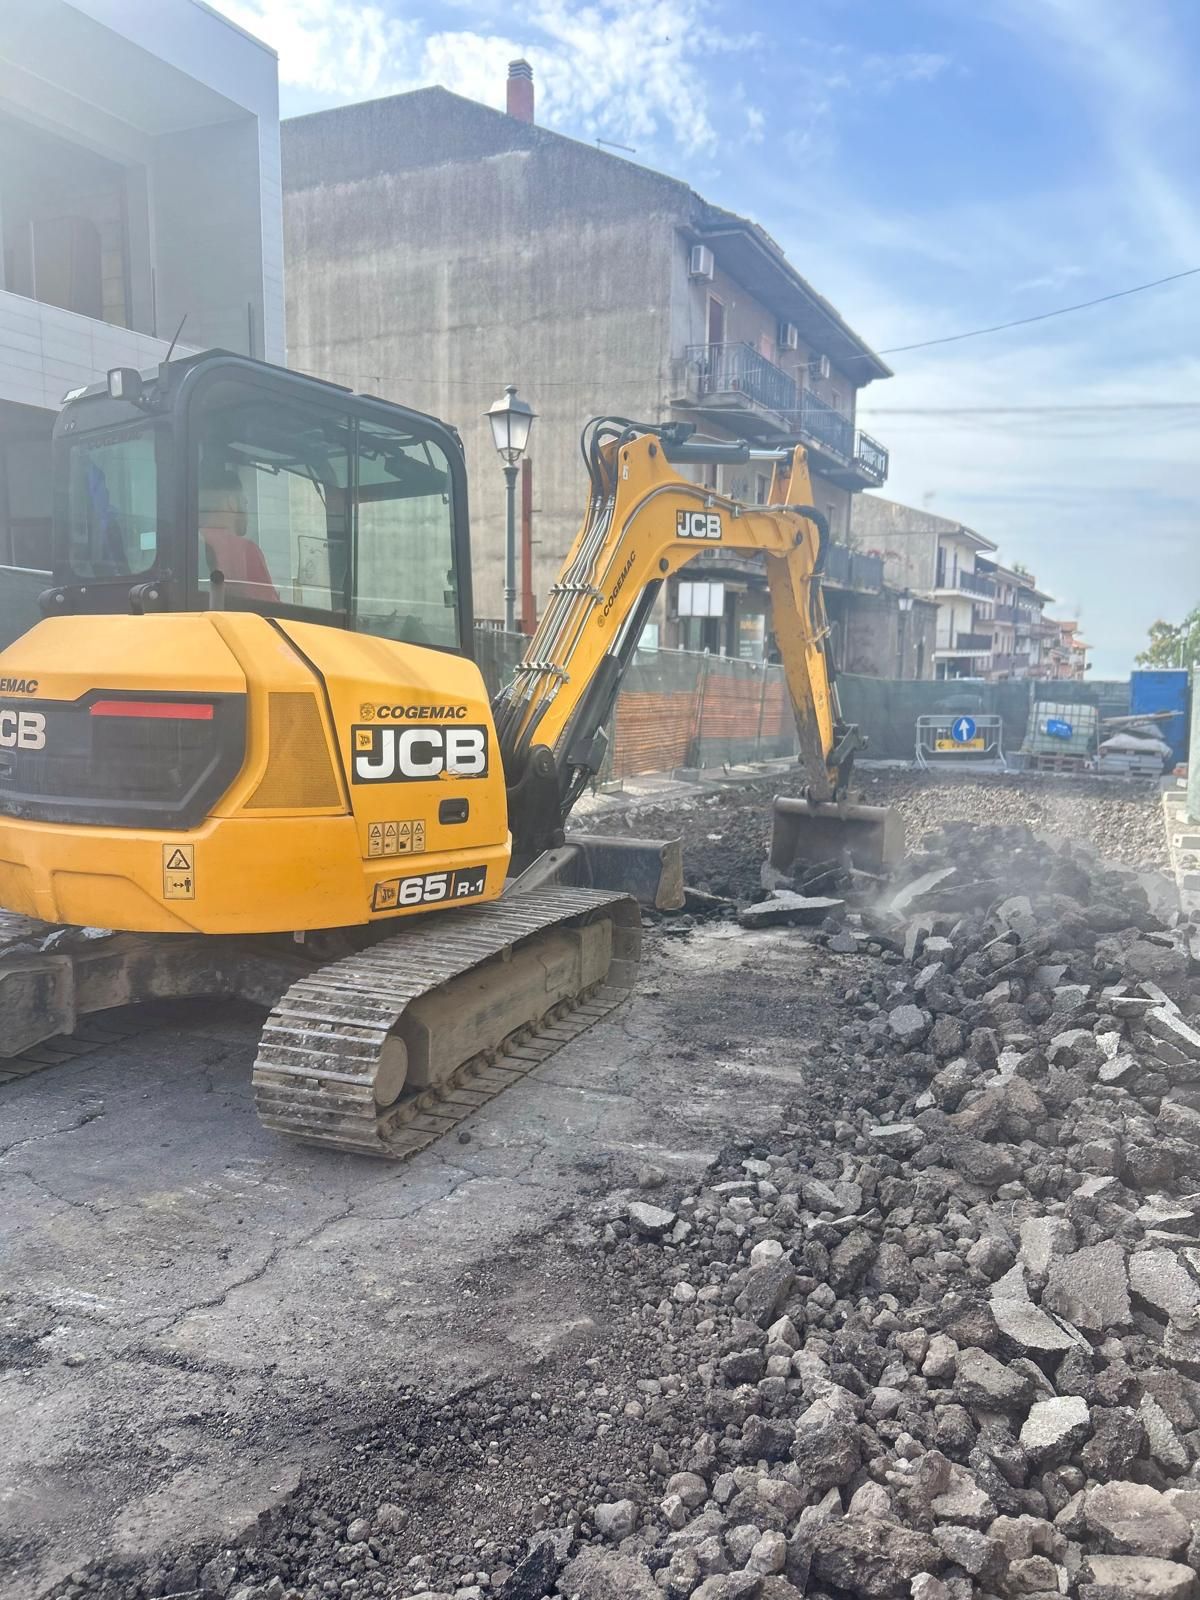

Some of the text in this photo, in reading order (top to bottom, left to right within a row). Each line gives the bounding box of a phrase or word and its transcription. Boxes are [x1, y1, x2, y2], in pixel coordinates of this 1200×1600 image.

[677, 512, 721, 538] JCB
[603, 550, 636, 617] COGEMAC
[376, 705, 468, 719] COGEMAC
[356, 728, 486, 779] JCB
[399, 874, 448, 905] 65
[457, 879, 484, 896] R-1
